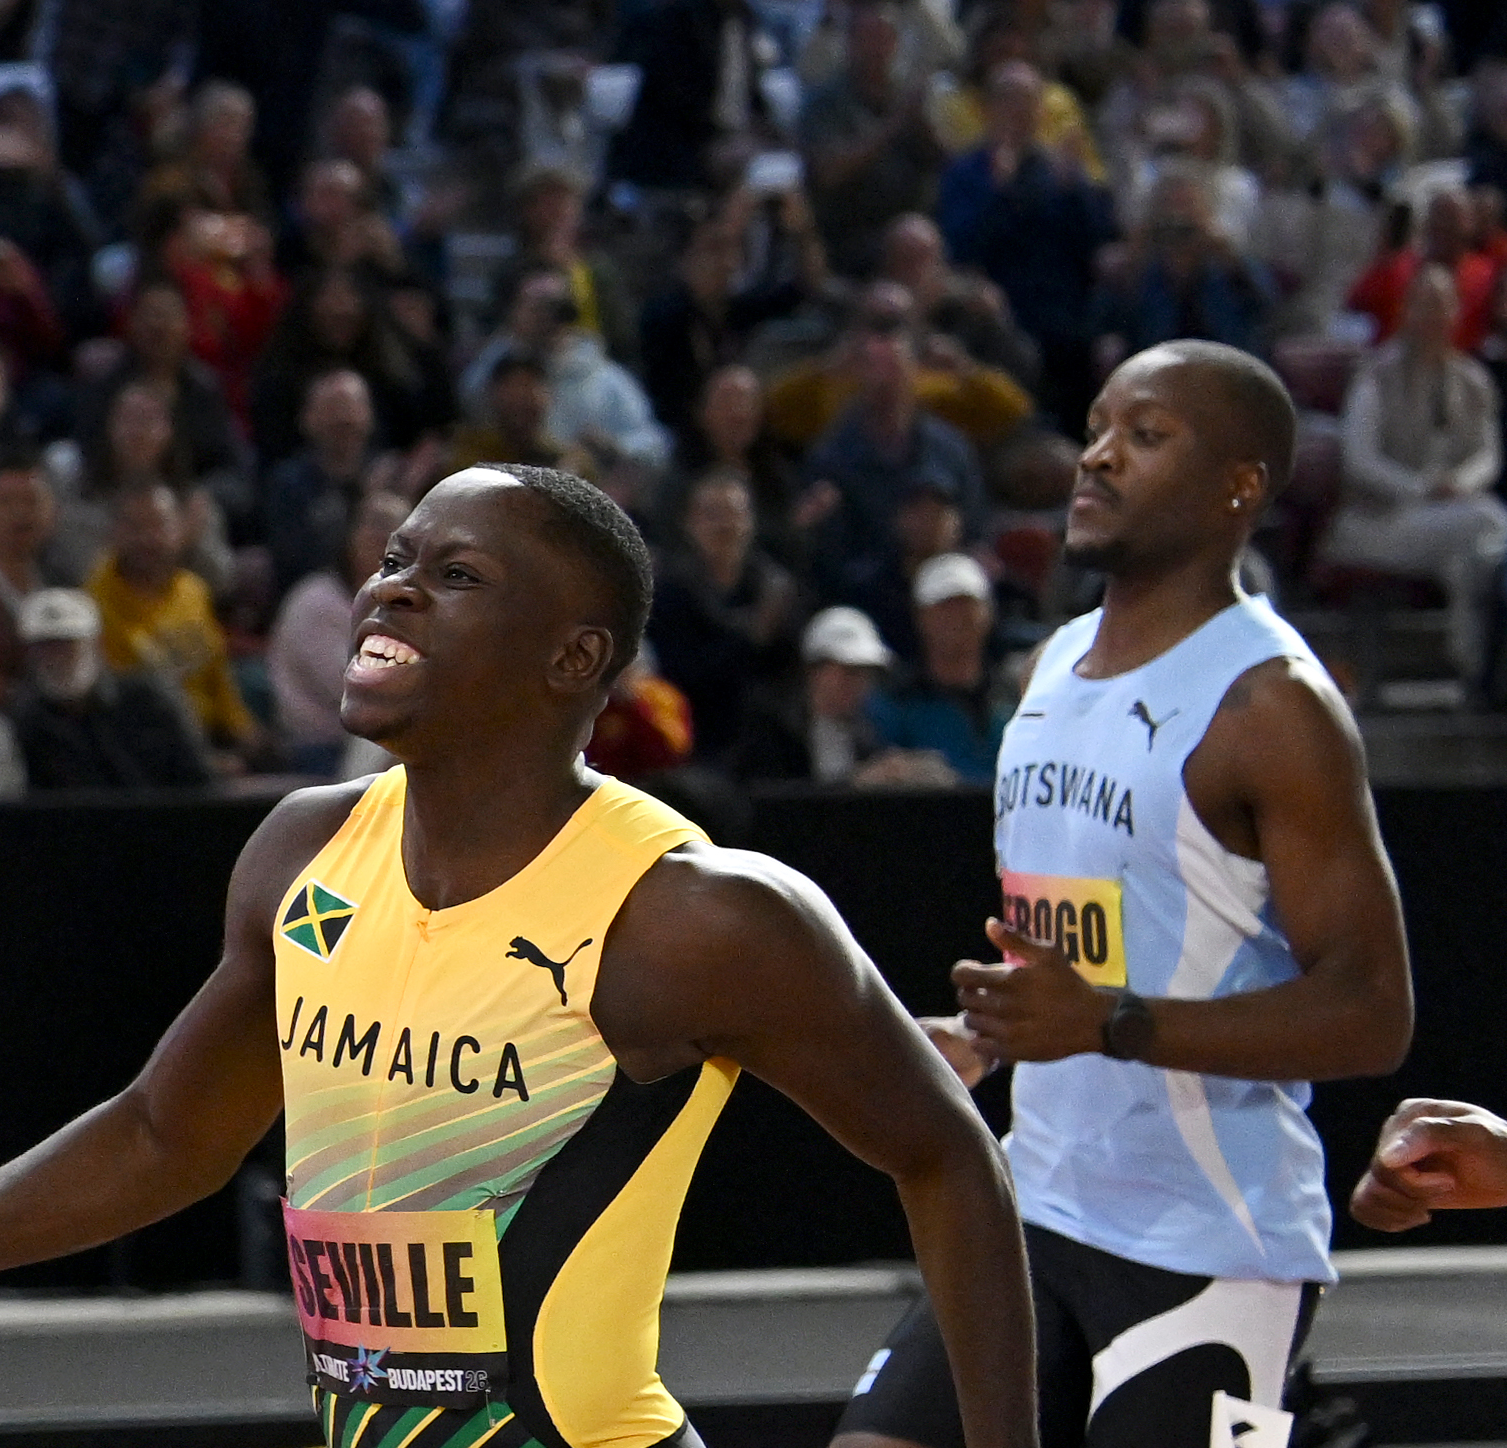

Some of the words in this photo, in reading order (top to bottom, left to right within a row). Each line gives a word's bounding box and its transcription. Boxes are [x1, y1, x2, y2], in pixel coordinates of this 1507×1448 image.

[281, 995, 530, 1102] JAMAICA
[289, 1233, 479, 1329] SEVILLE
[387, 1366, 464, 1393] BUDAPEST
